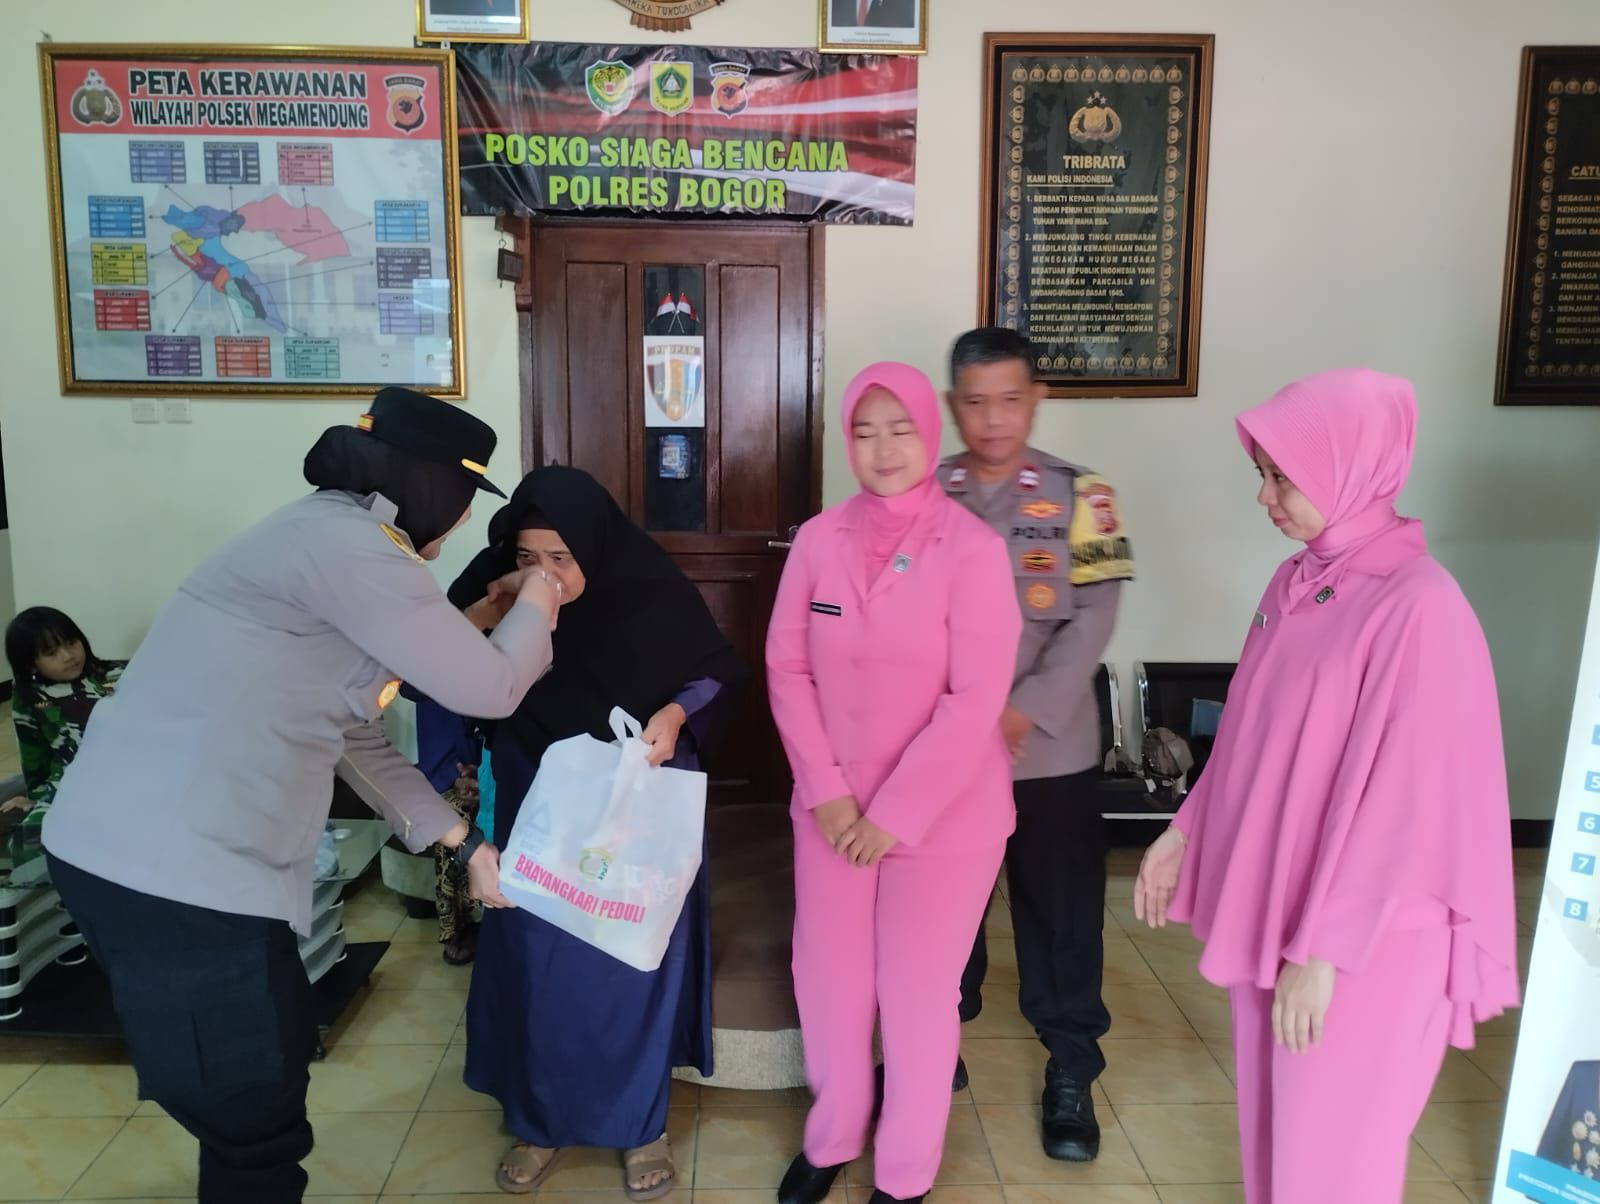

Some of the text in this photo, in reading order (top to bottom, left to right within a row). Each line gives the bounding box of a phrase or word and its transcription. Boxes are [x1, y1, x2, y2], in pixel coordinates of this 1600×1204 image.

[129, 70, 367, 98] PETA KERAWANAN
[130, 100, 369, 129] WILAYAH POLSEK MEGAMENDUNG
[485, 133, 850, 172] POSKO SIAGA BENCANA
[1062, 155, 1126, 169] TRIBRATA
[1026, 174, 1114, 184] KAMI POLISI INDONESIA
[549, 175, 787, 209] POLRES BOGOR
[1034, 195, 1068, 203] BERBAKTI
[1068, 195, 1094, 203] KEPADA
[1096, 195, 1115, 203] NUSA
[1116, 195, 1130, 203] DAN
[1131, 195, 1158, 203] BANGSA
[1033, 206, 1060, 214] DENGAN
[1060, 206, 1083, 214] PENUH
[1125, 206, 1158, 214] TERHADAP
[1033, 217, 1056, 225] TUHAN
[1056, 217, 1074, 225] YANG
[1032, 233, 1085, 241] MENJUNGJUNG
[1088, 233, 1112, 241] TINGGI
[1115, 233, 1157, 241] KEBENARAN
[1032, 244, 1158, 252] KEADILAN DAN KEMANUSIAAN DALAM
[1032, 255, 1156, 263] MENEGAKAN HUKUM NEGARA
[1031, 267, 1155, 275] KESATUAN REPUBLIK INDONESIA YANG
[1031, 278, 1155, 286] BERDASARKAN PANCASILA DAN
[1085, 289, 1108, 297] DASAR
[1030, 303, 1071, 311] SENANTIASA
[1115, 303, 1153, 311] MENGAYOMI
[1030, 314, 1154, 322] DAN MELAYANI MASYARAKAT DENGAN
[1030, 325, 1154, 333] KEIKHLASAN UNTUK MEWUJUDKAN
[1065, 336, 1079, 344] DAN
[1583, 816, 1596, 830] 6
[1577, 856, 1591, 871] 7
[513, 852, 600, 916] BHAYANGKARI
[598, 899, 647, 924] PEDULI
[1569, 902, 1582, 917] 8
